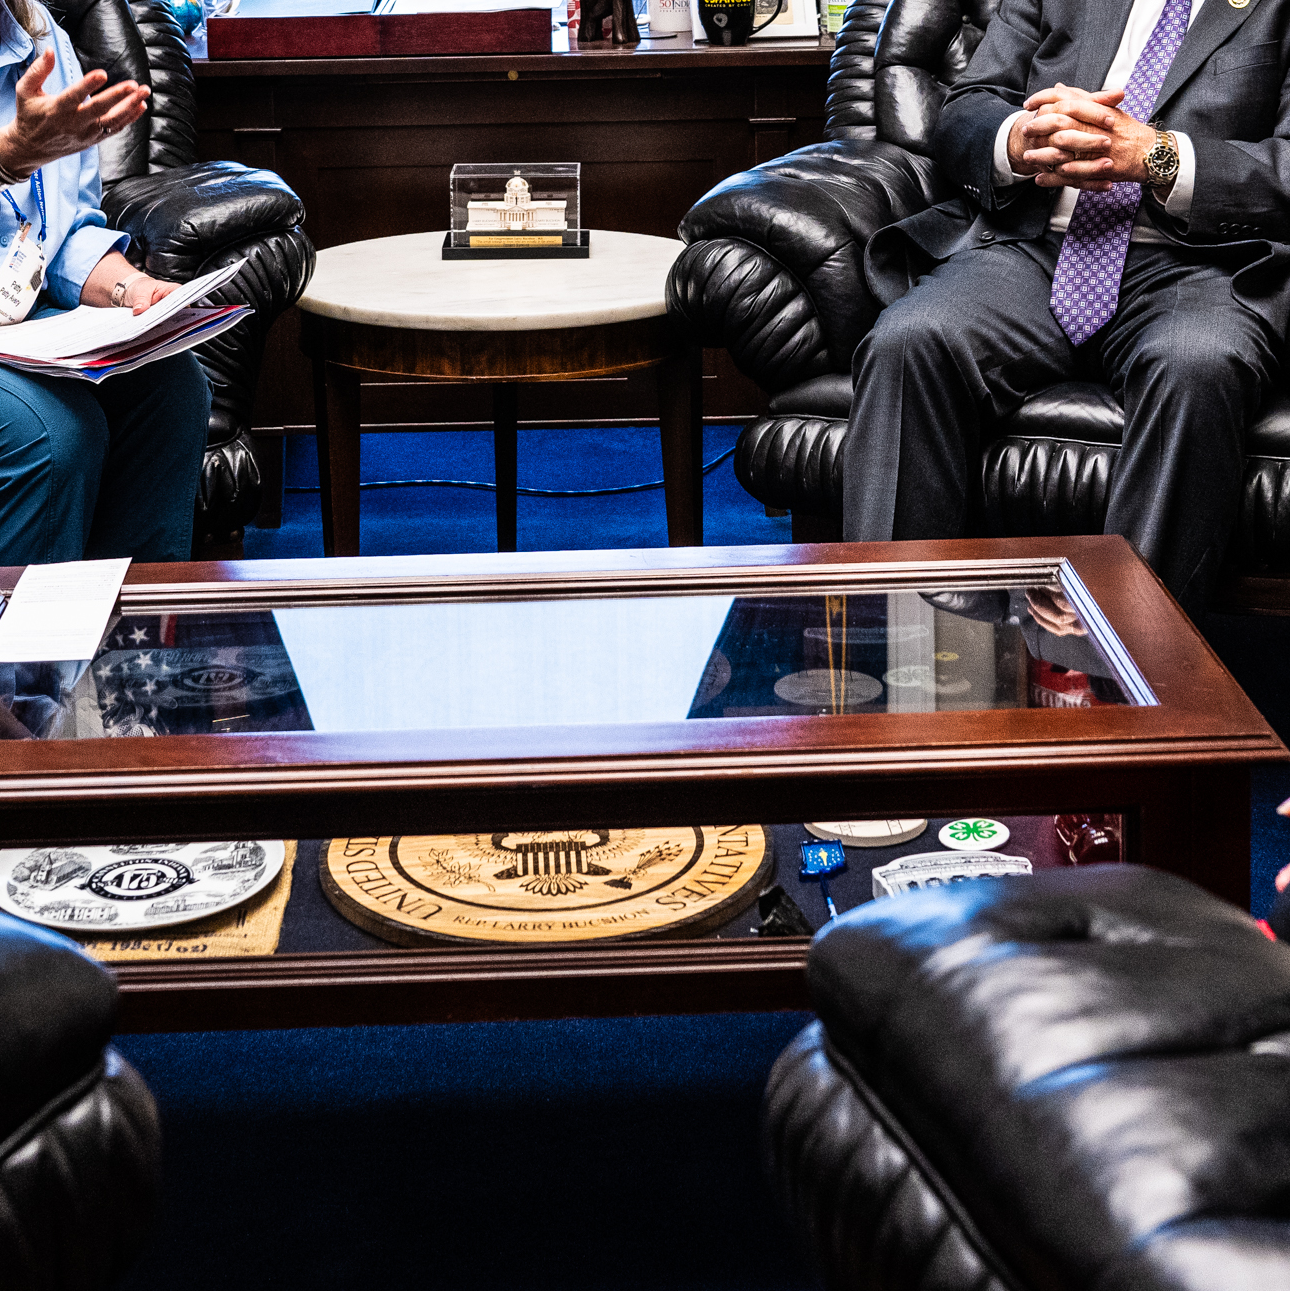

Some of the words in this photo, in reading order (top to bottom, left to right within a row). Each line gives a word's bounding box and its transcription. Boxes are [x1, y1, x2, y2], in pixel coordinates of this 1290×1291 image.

[659, 0, 672, 8] 50
[0, 287, 11, 300] Patty
[11, 280, 23, 294] Patty
[492, 920, 556, 931] LARRY
[562, 908, 652, 930] BUCSHON
